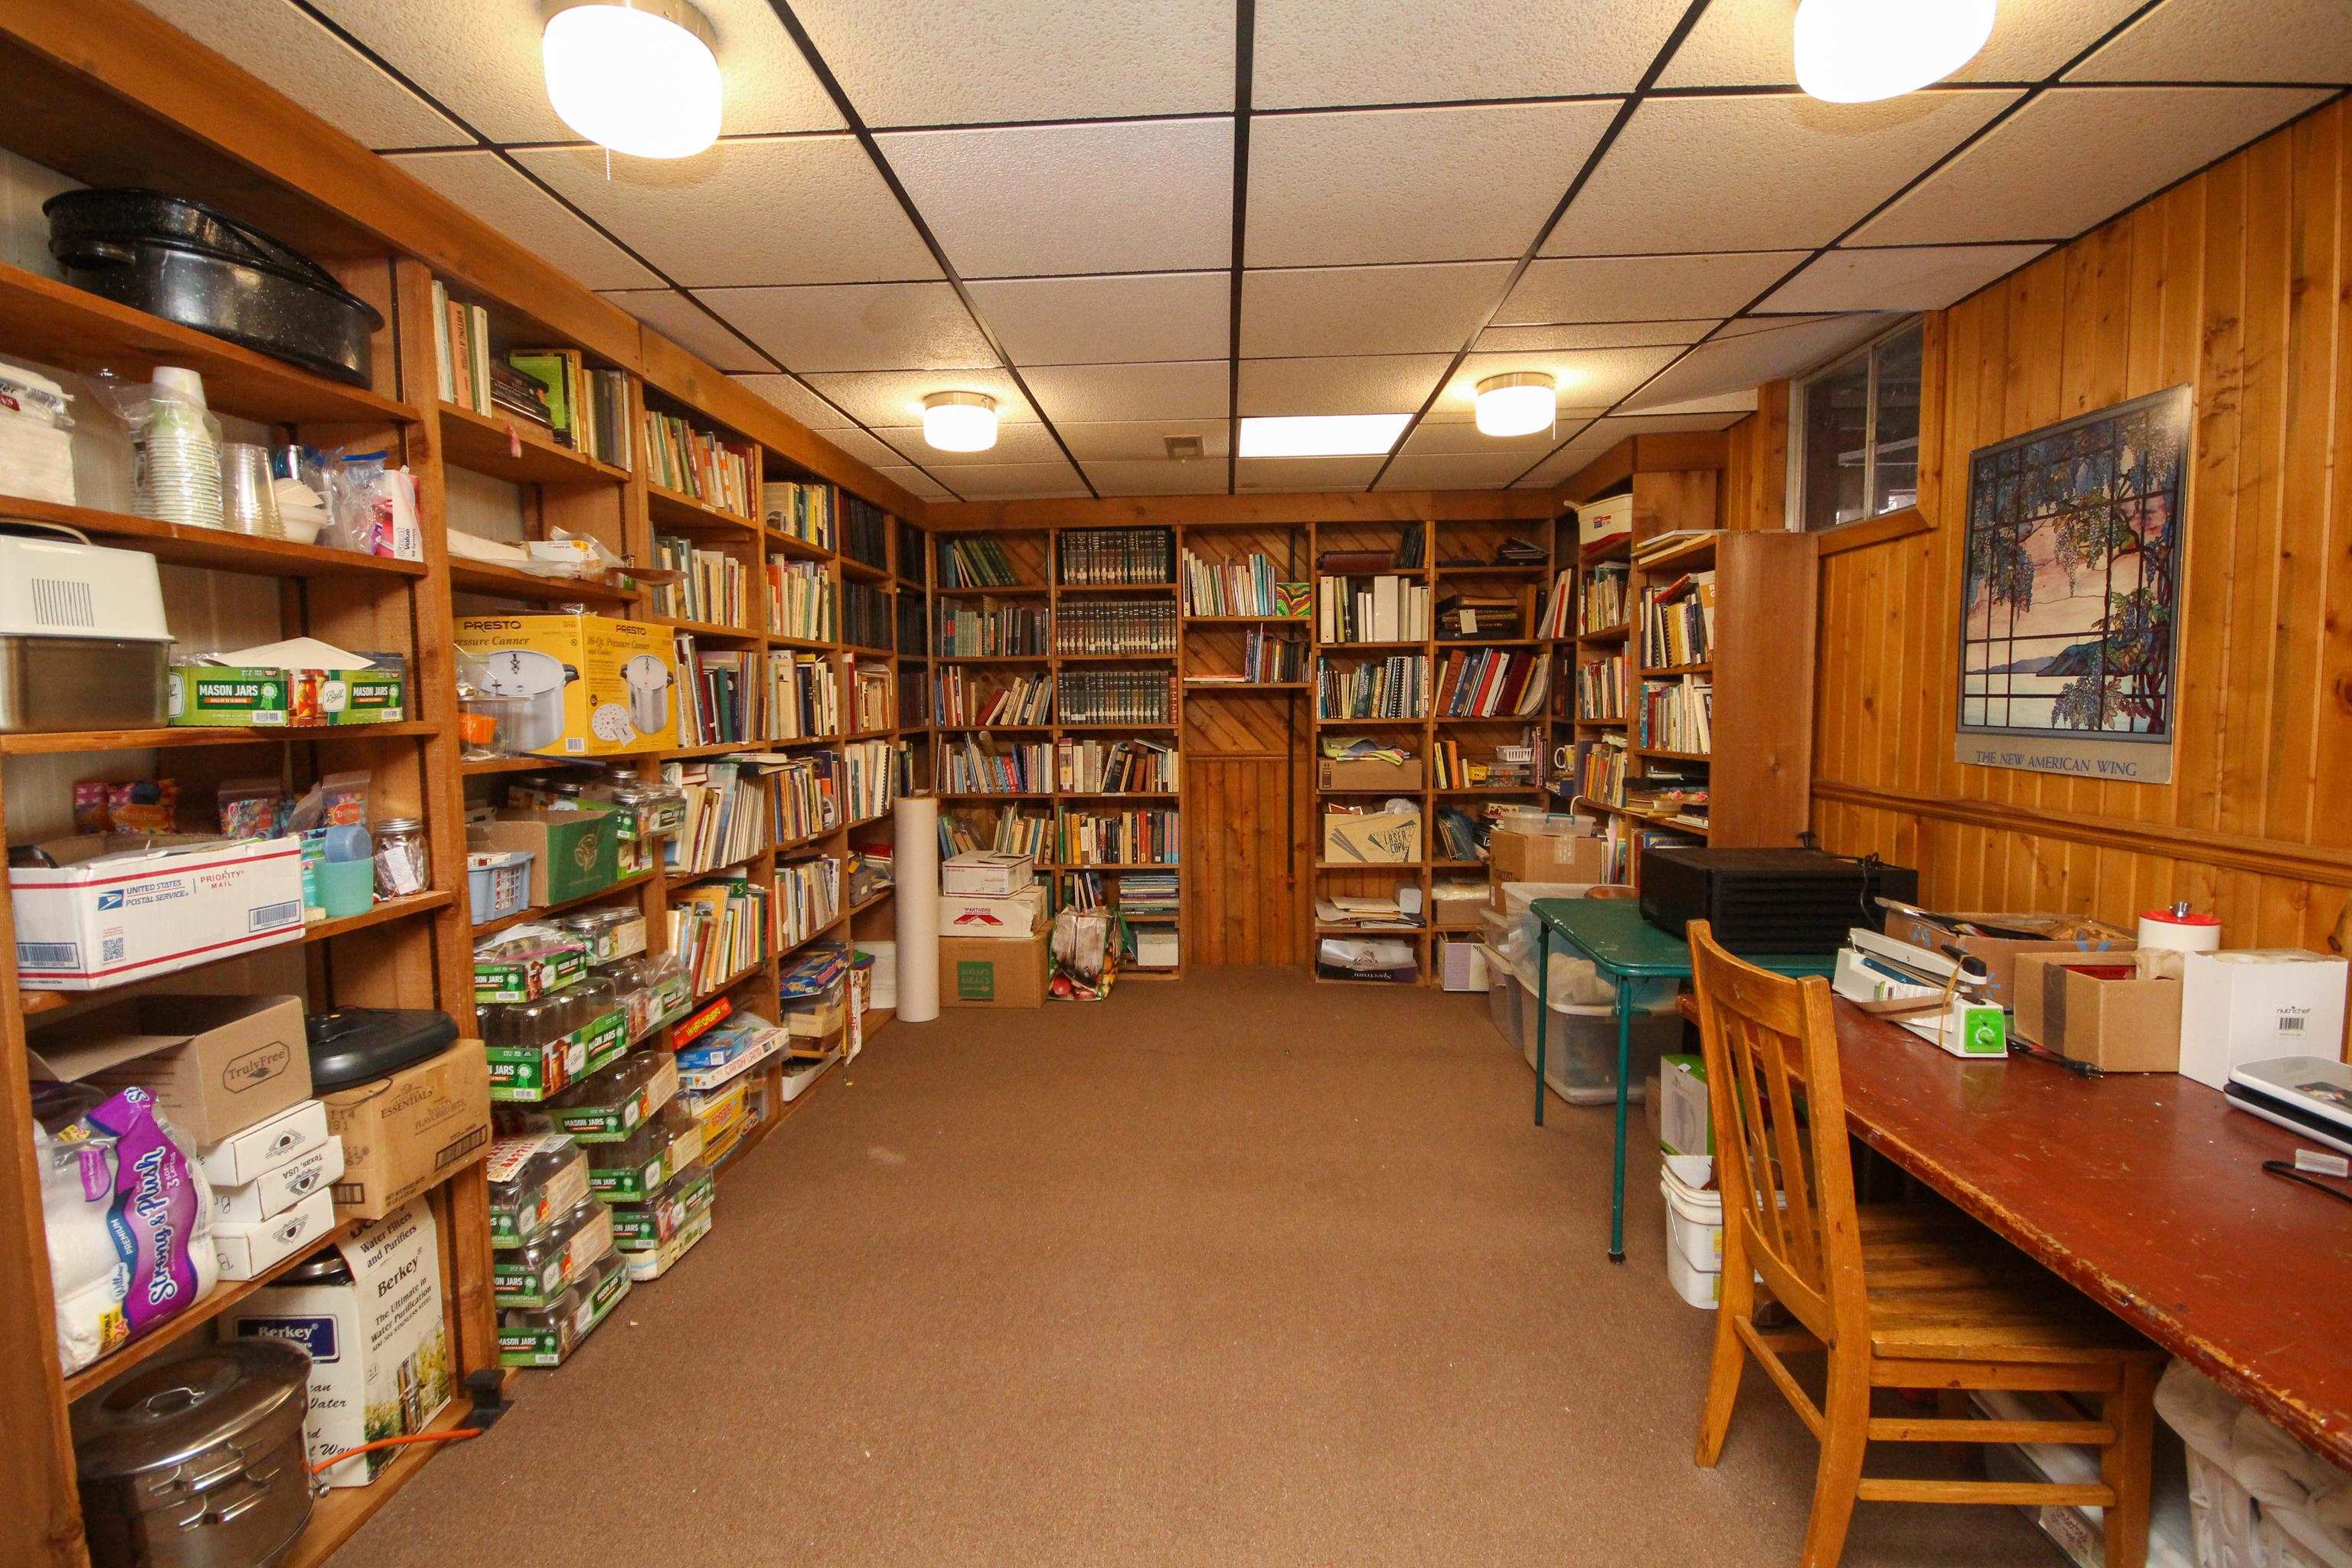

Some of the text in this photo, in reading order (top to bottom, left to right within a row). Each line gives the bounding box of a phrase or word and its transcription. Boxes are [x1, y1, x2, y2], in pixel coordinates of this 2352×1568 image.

[463, 620, 522, 632] PRESTO
[616, 624, 647, 637] PRESTO
[453, 635, 530, 646] ressure Canner
[606, 637, 629, 649] Pressure
[631, 640, 650, 650] Canner
[199, 684, 259, 696] MASON JARS
[325, 688, 345, 704] Ball
[353, 685, 389, 697] MASON JARS
[1976, 750, 2138, 776] THE NEW AMERICAN WING
[1383, 830, 1407, 844] LASER
[1390, 841, 1405, 854] COPY
[126, 880, 182, 895] UNITED STATES
[211, 881, 232, 890] MAIL
[729, 883, 743, 894] TS
[126, 895, 155, 906] POSTAL
[488, 975, 504, 983] JARS
[1353, 972, 1393, 980] Spectrum
[603, 1029, 616, 1044] JARS
[227, 1050, 286, 1080] TrulyFree
[494, 1065, 514, 1075] JARS
[588, 1118, 605, 1126] JARS
[283, 1153, 323, 1179] Texas, USA
[134, 1146, 178, 1305] Strong & Plush
[612, 1223, 639, 1232] SON JARS
[111, 1219, 132, 1255] PREMIUM
[360, 1227, 386, 1254] Water
[386, 1212, 413, 1236] Filters
[367, 1224, 417, 1269] and Purifiers
[505, 1277, 523, 1286] JARS
[374, 1276, 427, 1327] The Ultimate in
[371, 1285, 432, 1343] Water Purification
[394, 1307, 420, 1334] STAINLESS
[520, 1338, 537, 1346] JARS
